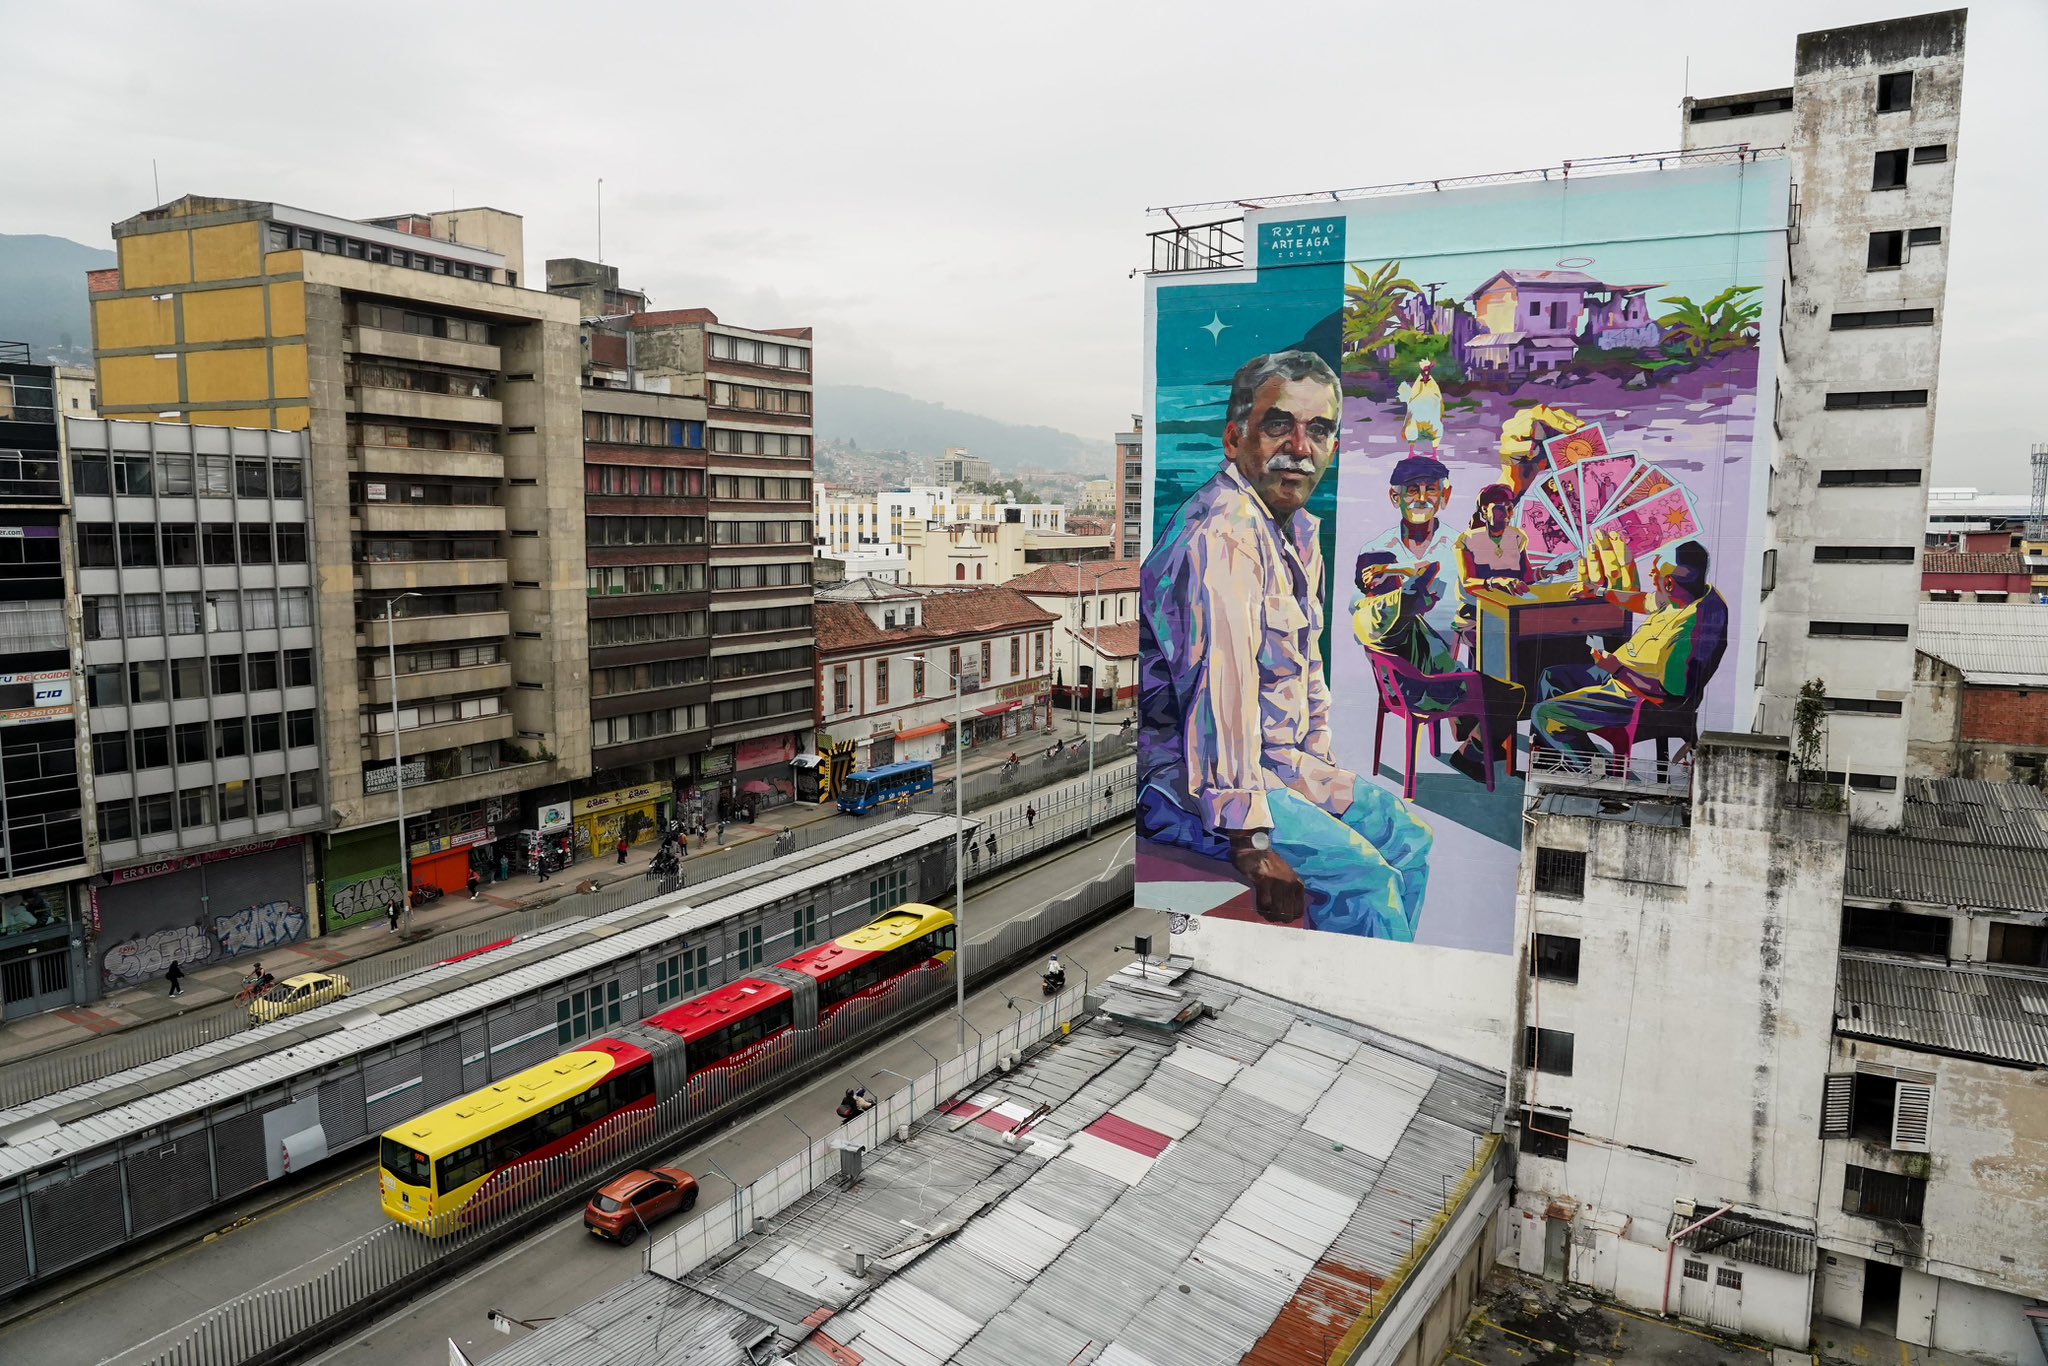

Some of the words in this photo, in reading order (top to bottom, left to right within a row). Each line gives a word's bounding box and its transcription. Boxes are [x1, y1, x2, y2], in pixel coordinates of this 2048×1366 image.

[1272, 236, 1330, 250] ARTEAGA
[10, 711, 29, 719] 320
[29, 709, 46, 717] 261
